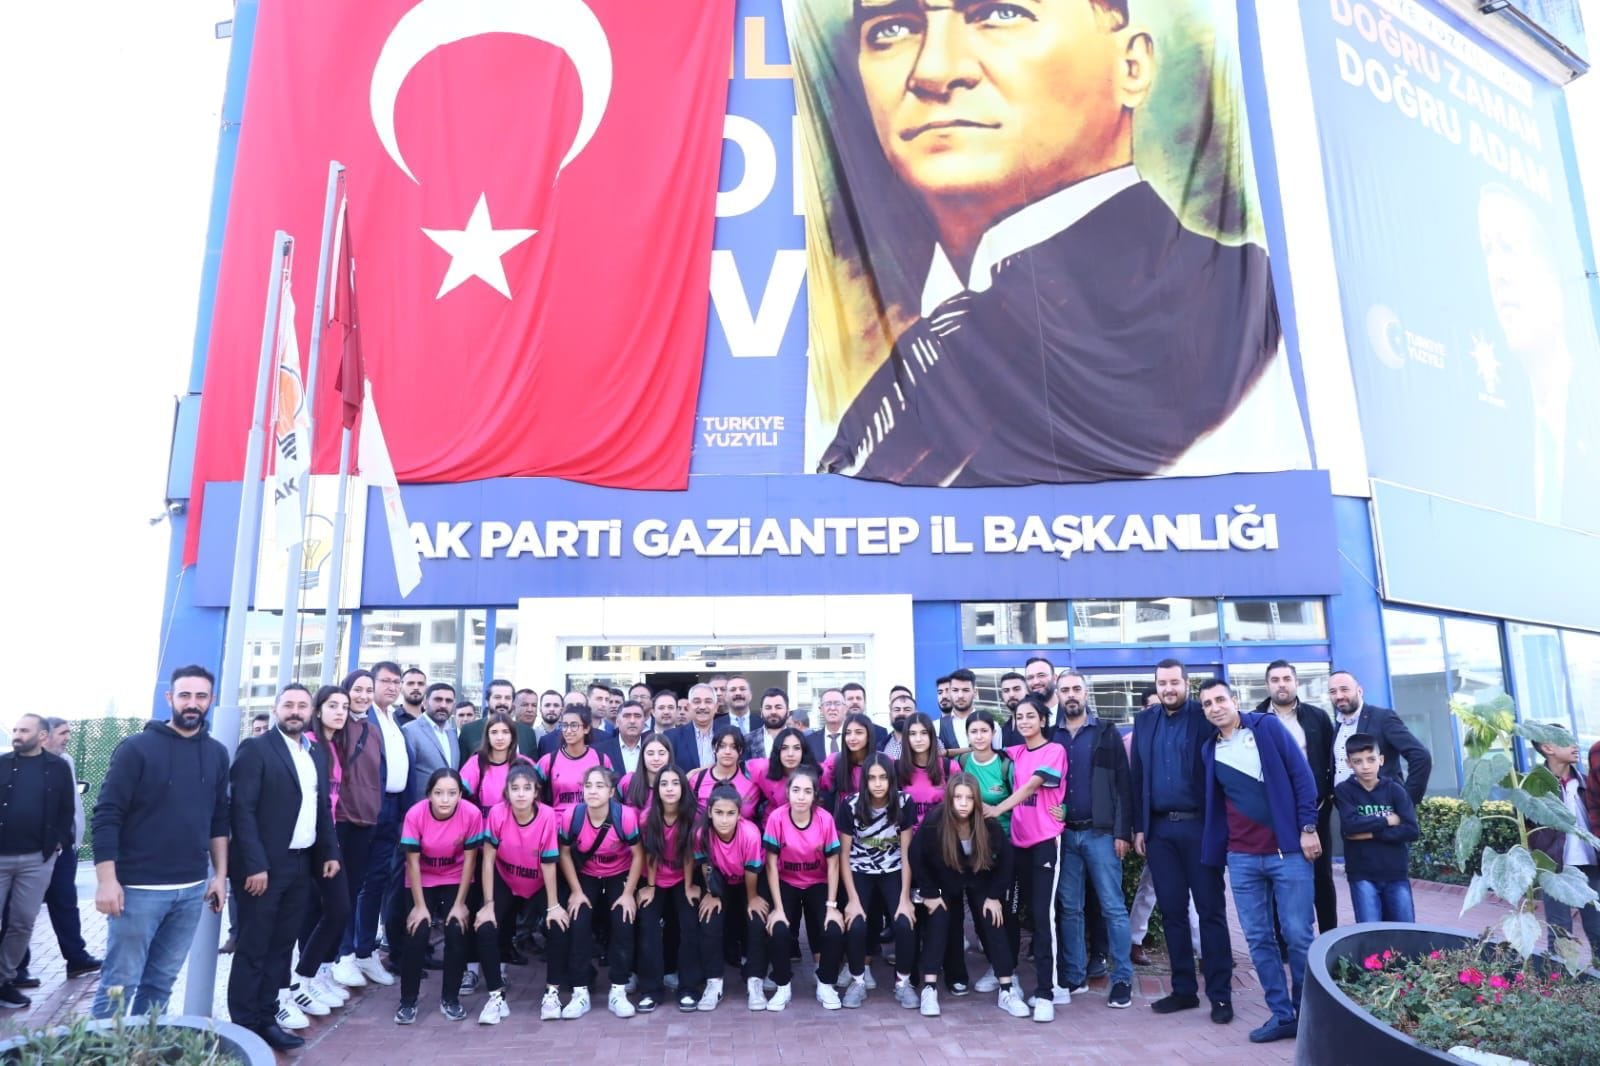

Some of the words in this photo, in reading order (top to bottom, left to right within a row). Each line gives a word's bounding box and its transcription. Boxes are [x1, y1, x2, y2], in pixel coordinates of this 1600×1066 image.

[1336, 38, 1462, 145] DOĞRU
[1469, 119, 1553, 203] ADAM
[274, 477, 299, 505] AK
[409, 521, 473, 558] AK
[983, 503, 1279, 560] BAŞKANLIĞI
